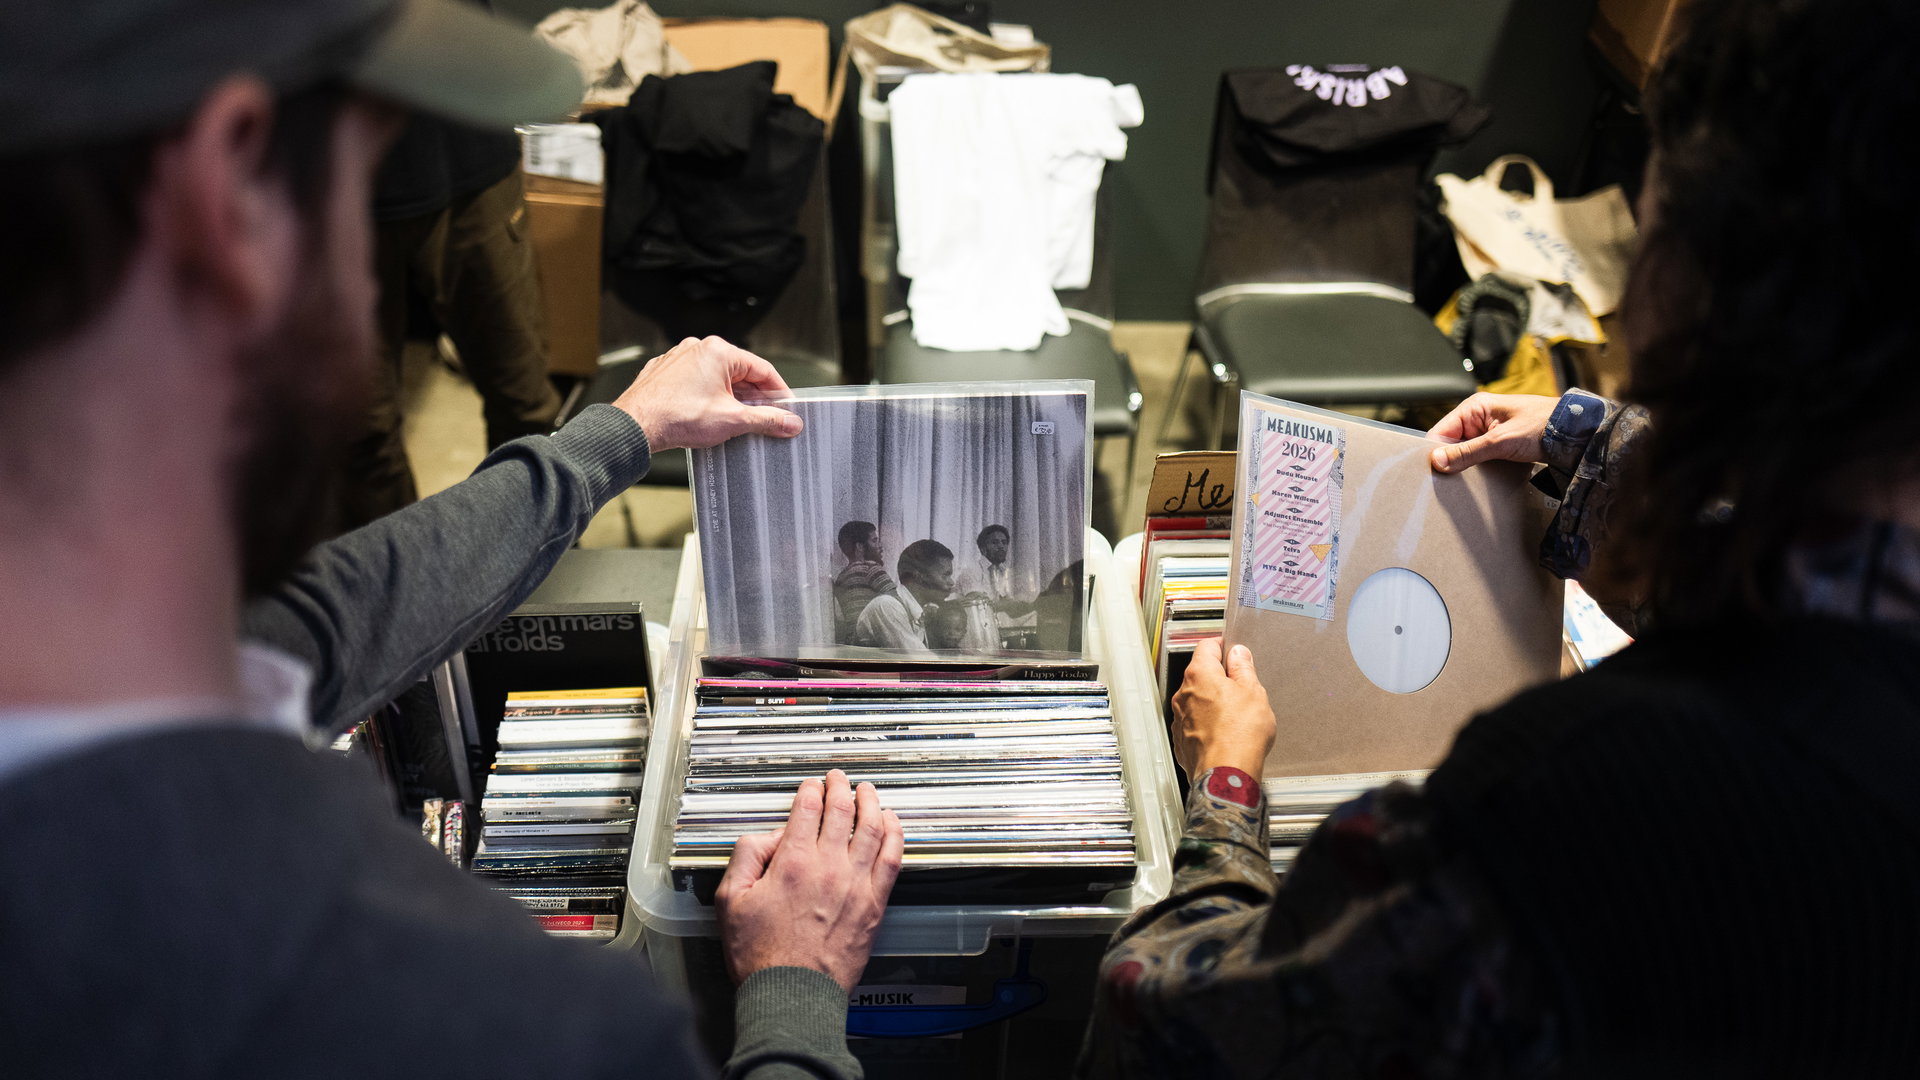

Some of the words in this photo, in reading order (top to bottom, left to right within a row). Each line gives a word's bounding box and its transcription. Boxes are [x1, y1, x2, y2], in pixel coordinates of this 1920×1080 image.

[1285, 64, 1409, 107] ABRISK
[1267, 416, 1333, 445] MEAKUSMA
[1281, 440, 1316, 462] 2026
[1163, 468, 1234, 513] Me
[1271, 490, 1292, 499] Karen
[1294, 494, 1320, 504] Willems
[1264, 510, 1292, 520] Adjunct
[1292, 515, 1324, 526] Ensemble
[1297, 570, 1318, 579] Hands
[1273, 599, 1305, 609] meakusma.org
[518, 616, 556, 633] on
[560, 614, 635, 632] mars
[493, 631, 565, 653] folds
[1024, 669, 1055, 679] Happy
[1060, 669, 1090, 679] Today
